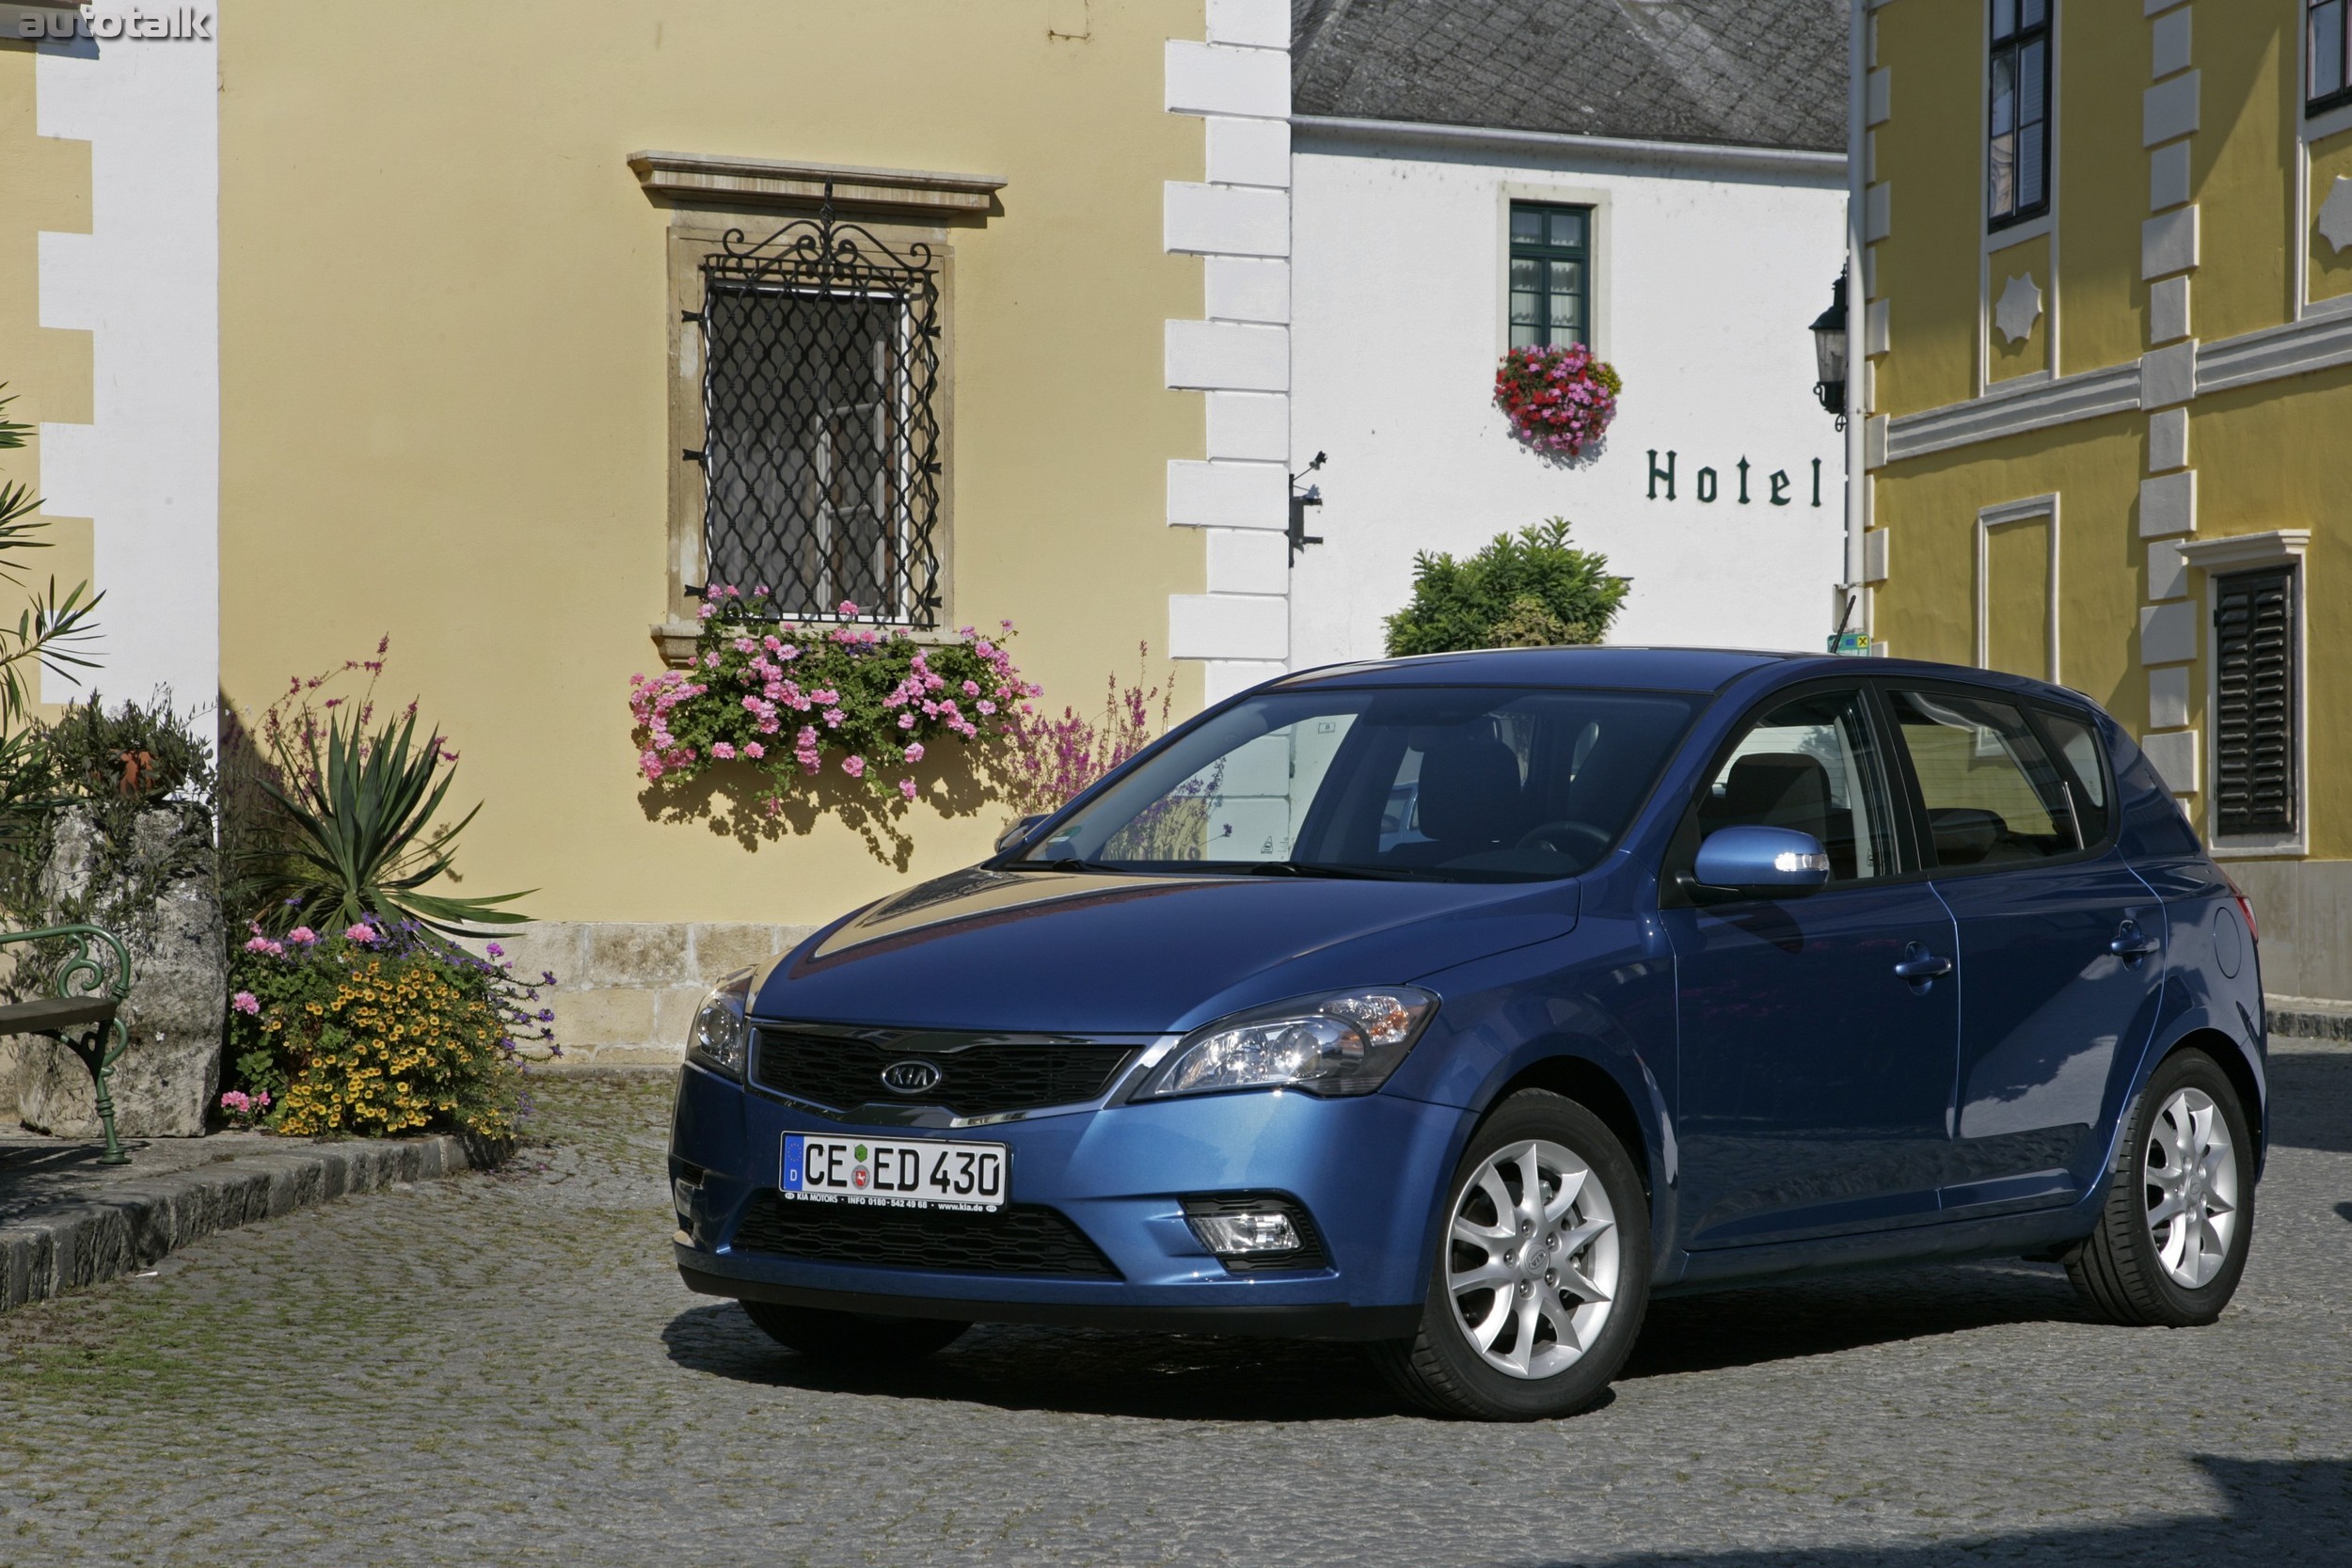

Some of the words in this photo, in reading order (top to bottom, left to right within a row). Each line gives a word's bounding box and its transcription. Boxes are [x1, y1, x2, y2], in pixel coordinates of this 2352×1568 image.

[1645, 449, 1822, 508] Hotel
[892, 1067, 928, 1086] KIA
[790, 1169, 798, 1181] D
[805, 1143, 848, 1187] CE
[873, 1148, 920, 1192] ED
[930, 1150, 1000, 1196] 430
[797, 1193, 808, 1201] KIA
[810, 1194, 838, 1203] MOTORS
[848, 1196, 866, 1205] INFO
[906, 1200, 916, 1209] 49
[938, 1203, 983, 1212] www.kia.de
[1531, 1251, 1546, 1267] KIA
